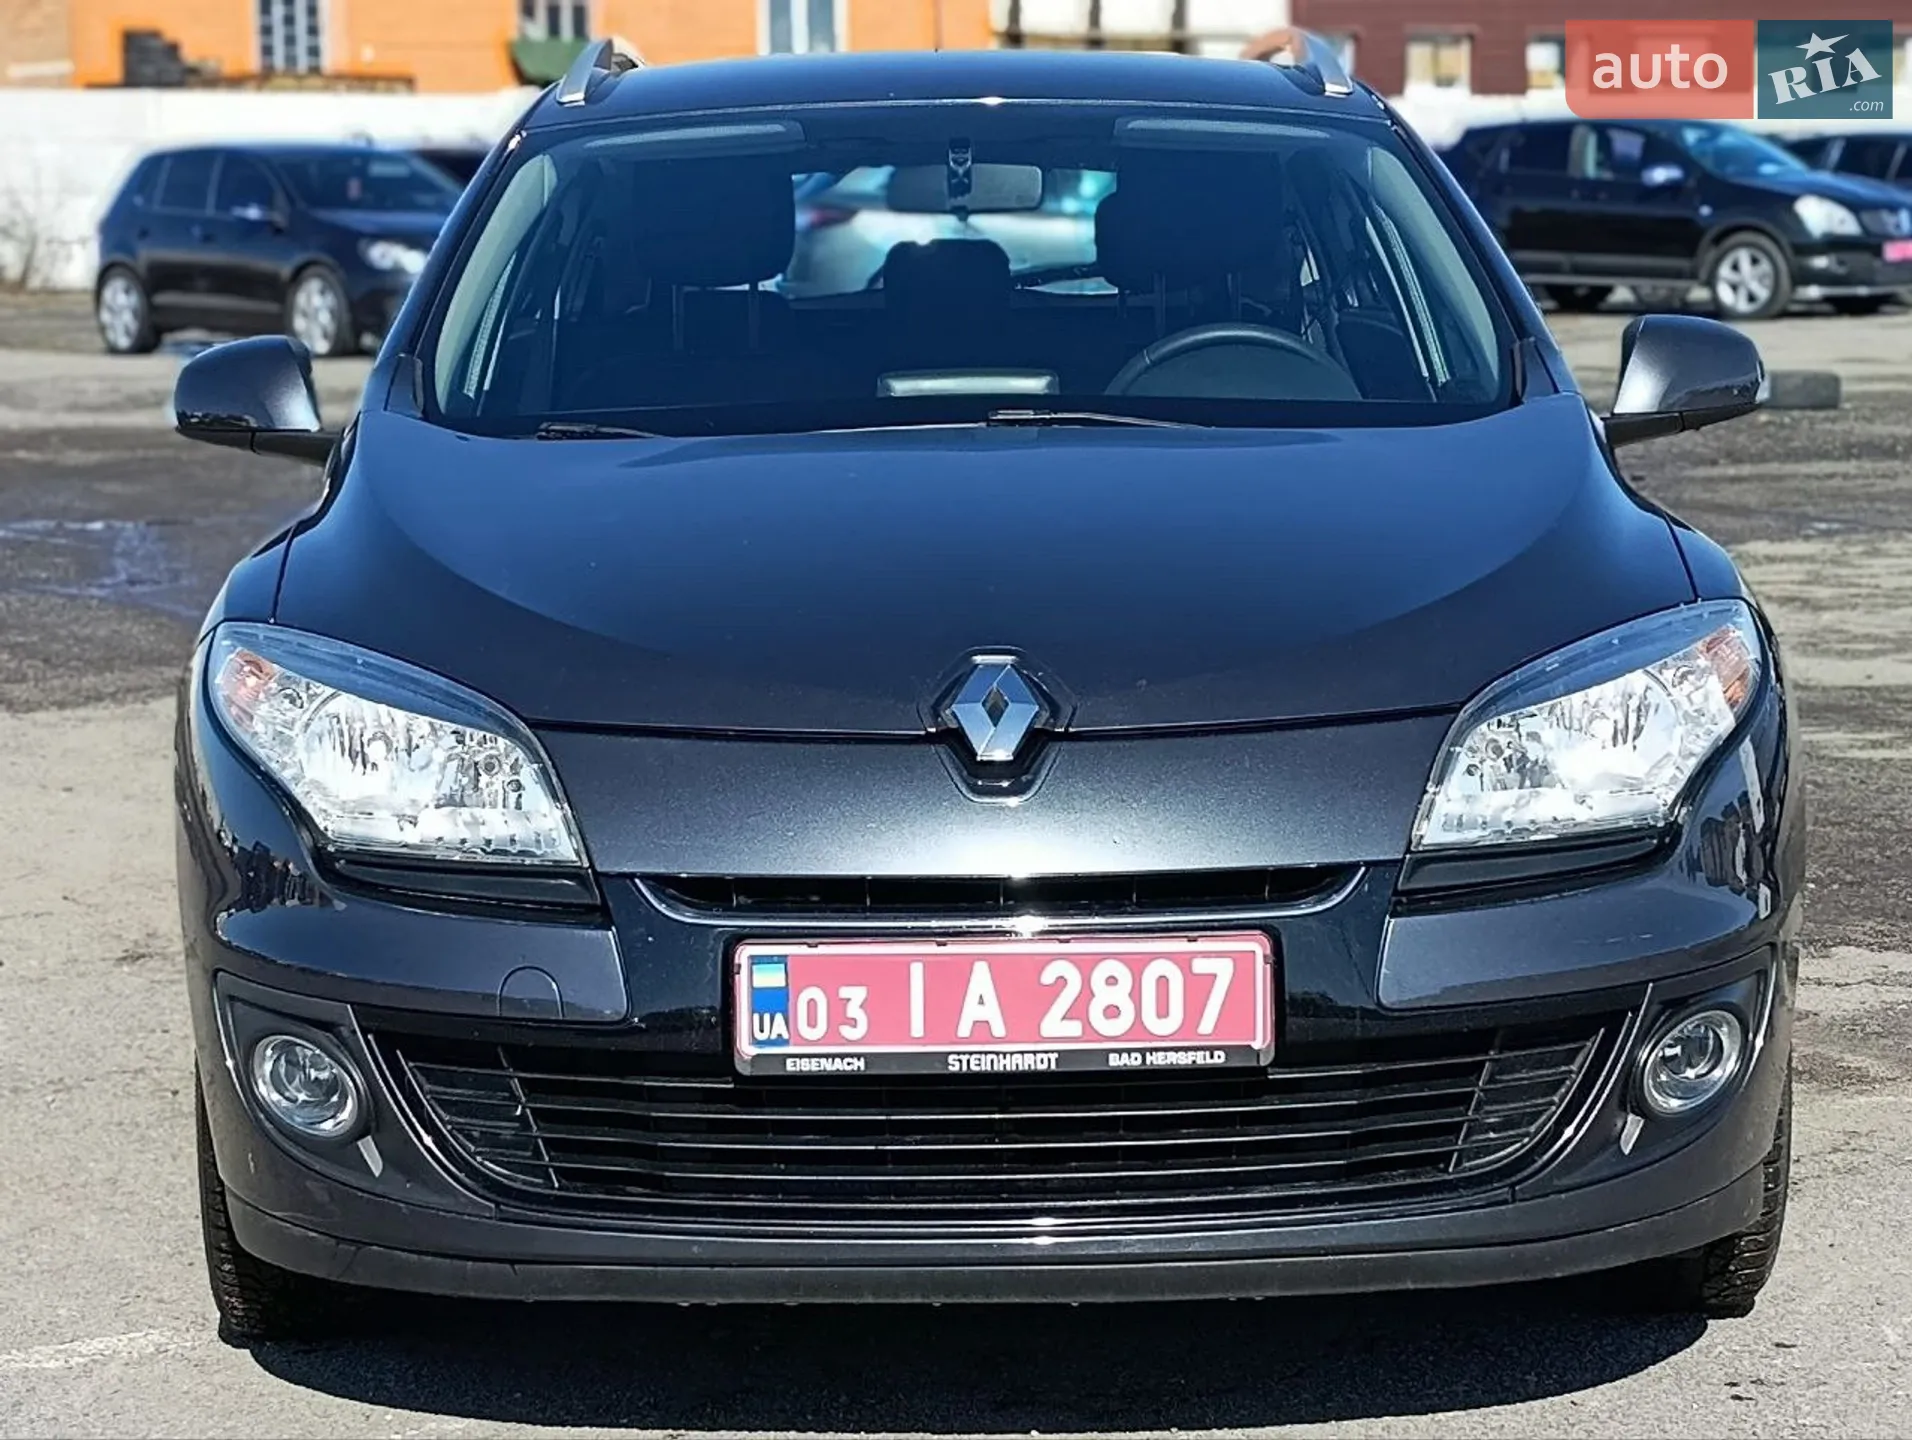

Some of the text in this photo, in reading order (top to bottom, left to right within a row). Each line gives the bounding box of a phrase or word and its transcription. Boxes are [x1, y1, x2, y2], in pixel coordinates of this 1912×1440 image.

[797, 986, 869, 1041] 03
[1039, 957, 1235, 1038] 2807
[752, 1012, 790, 1040] UA
[785, 1050, 1226, 1071] EISENACH STEINHARDT BAD HERSFELD
